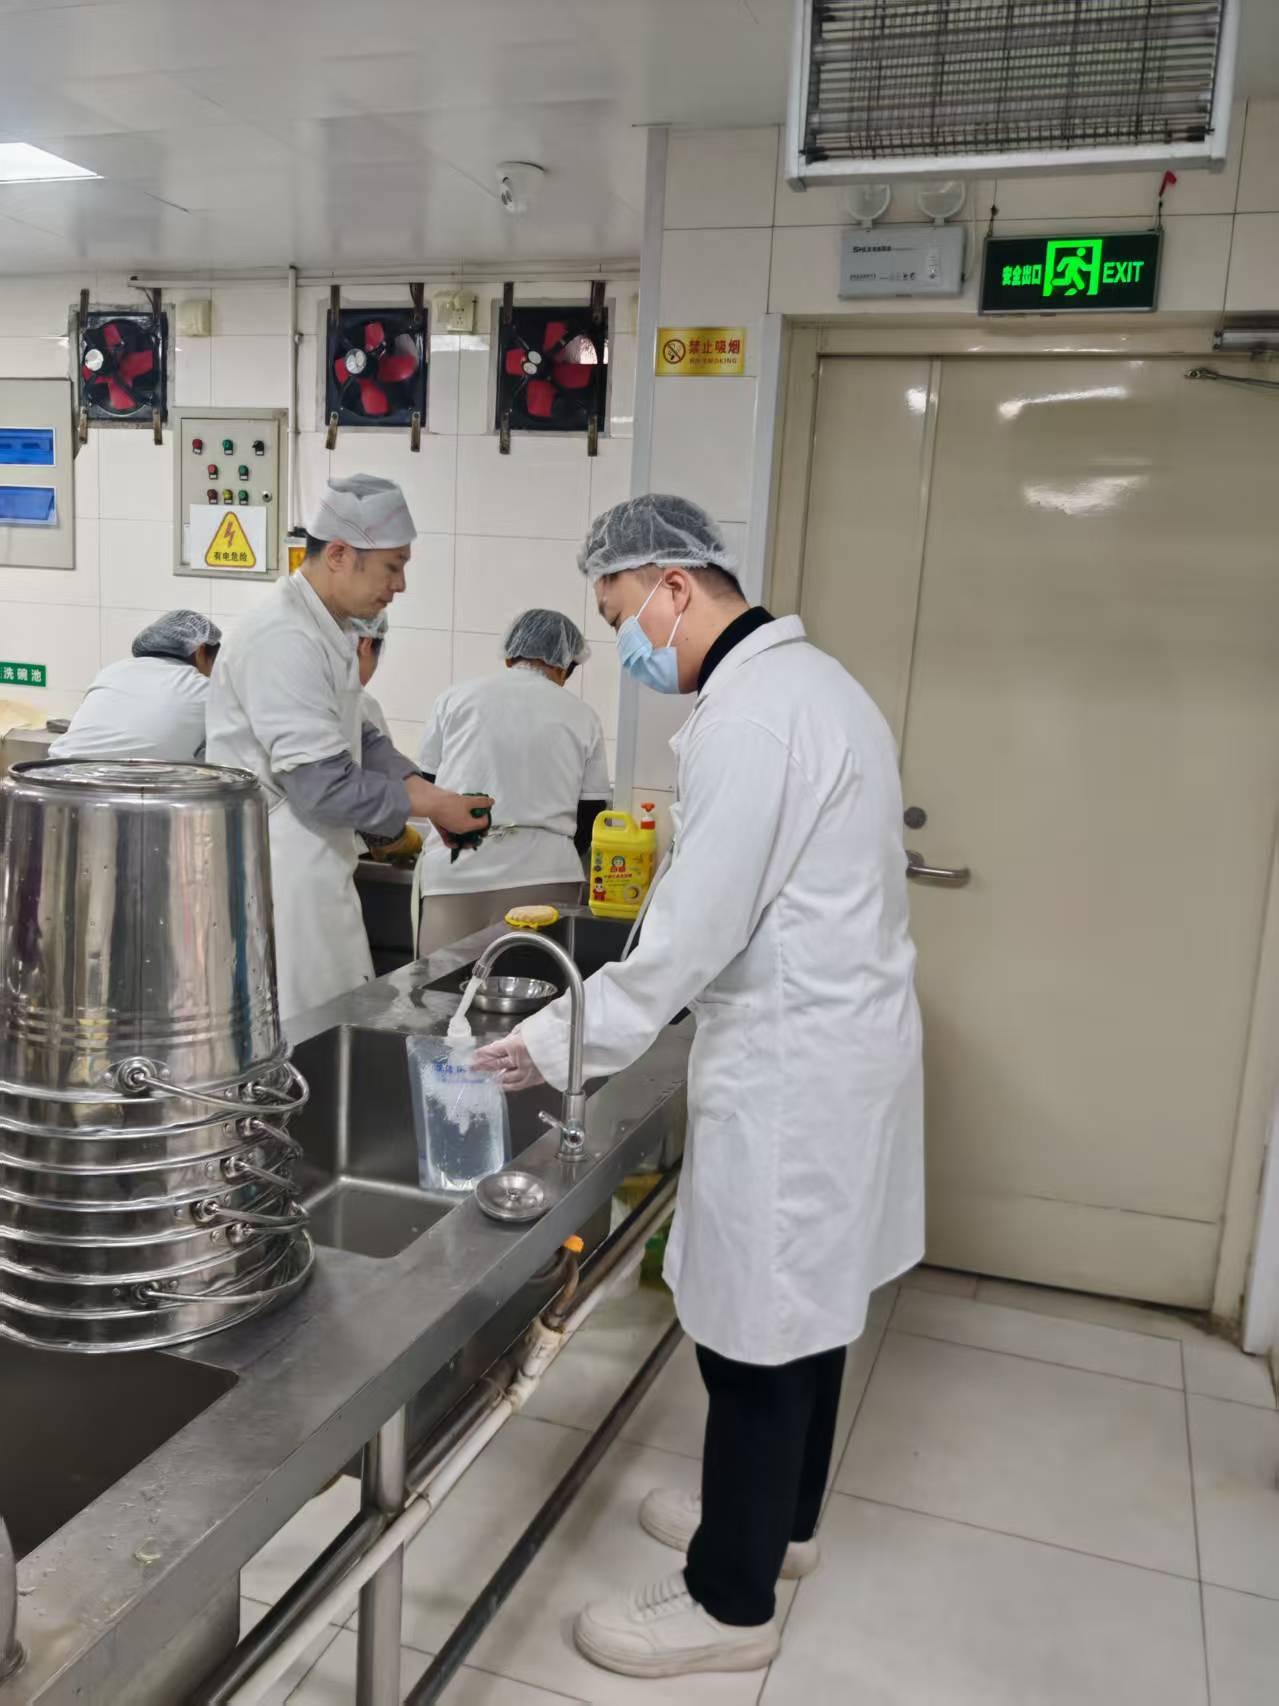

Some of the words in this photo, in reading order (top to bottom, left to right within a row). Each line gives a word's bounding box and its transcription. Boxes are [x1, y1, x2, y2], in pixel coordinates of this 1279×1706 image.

[1002, 264, 1042, 286] 安全出口
[1102, 261, 1145, 284] EXIT
[689, 339, 741, 354] 禁止吸烟
[214, 551, 248, 561] 有电危险
[0, 666, 42, 682] 洗碗池
